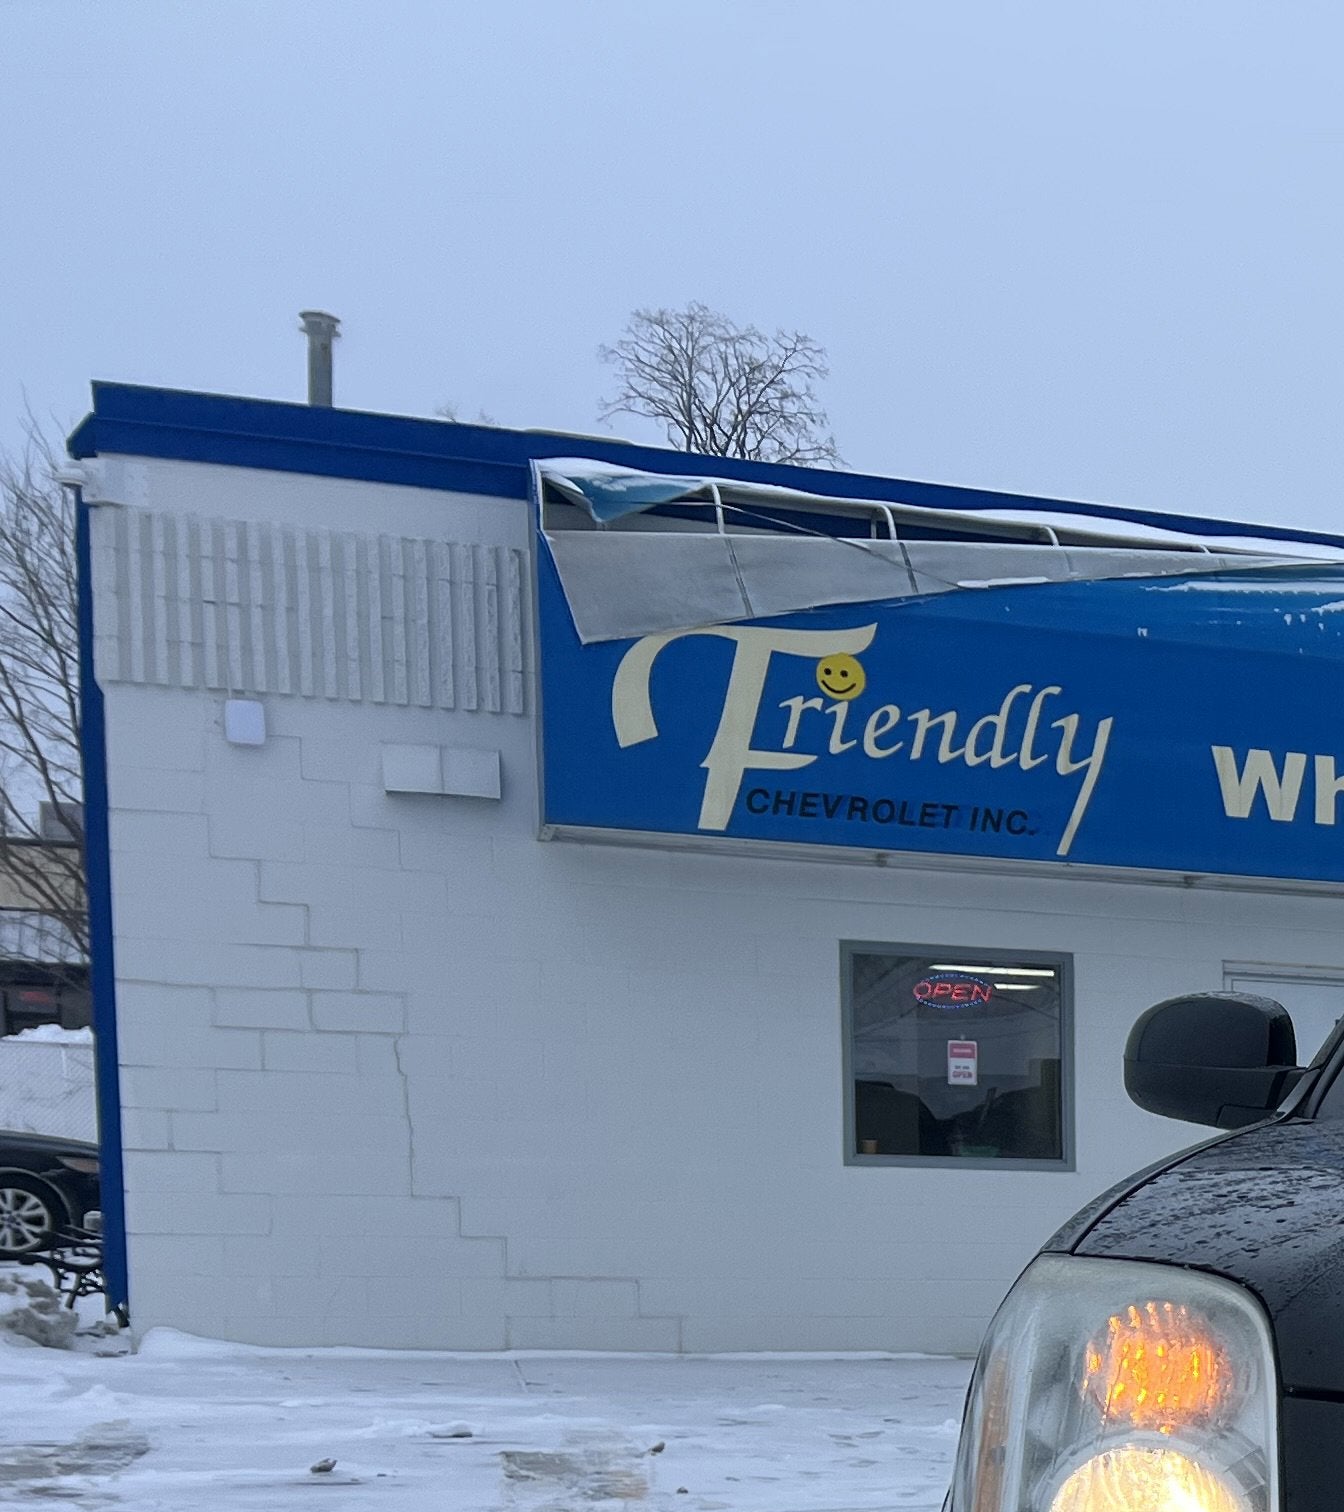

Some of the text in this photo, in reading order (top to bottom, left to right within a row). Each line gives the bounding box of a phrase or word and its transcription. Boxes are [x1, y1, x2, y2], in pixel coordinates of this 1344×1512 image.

[611, 622, 1114, 857] Friendly
[745, 788, 1037, 837] CHEVROLET INC.
[912, 981, 993, 1003] OPEN
